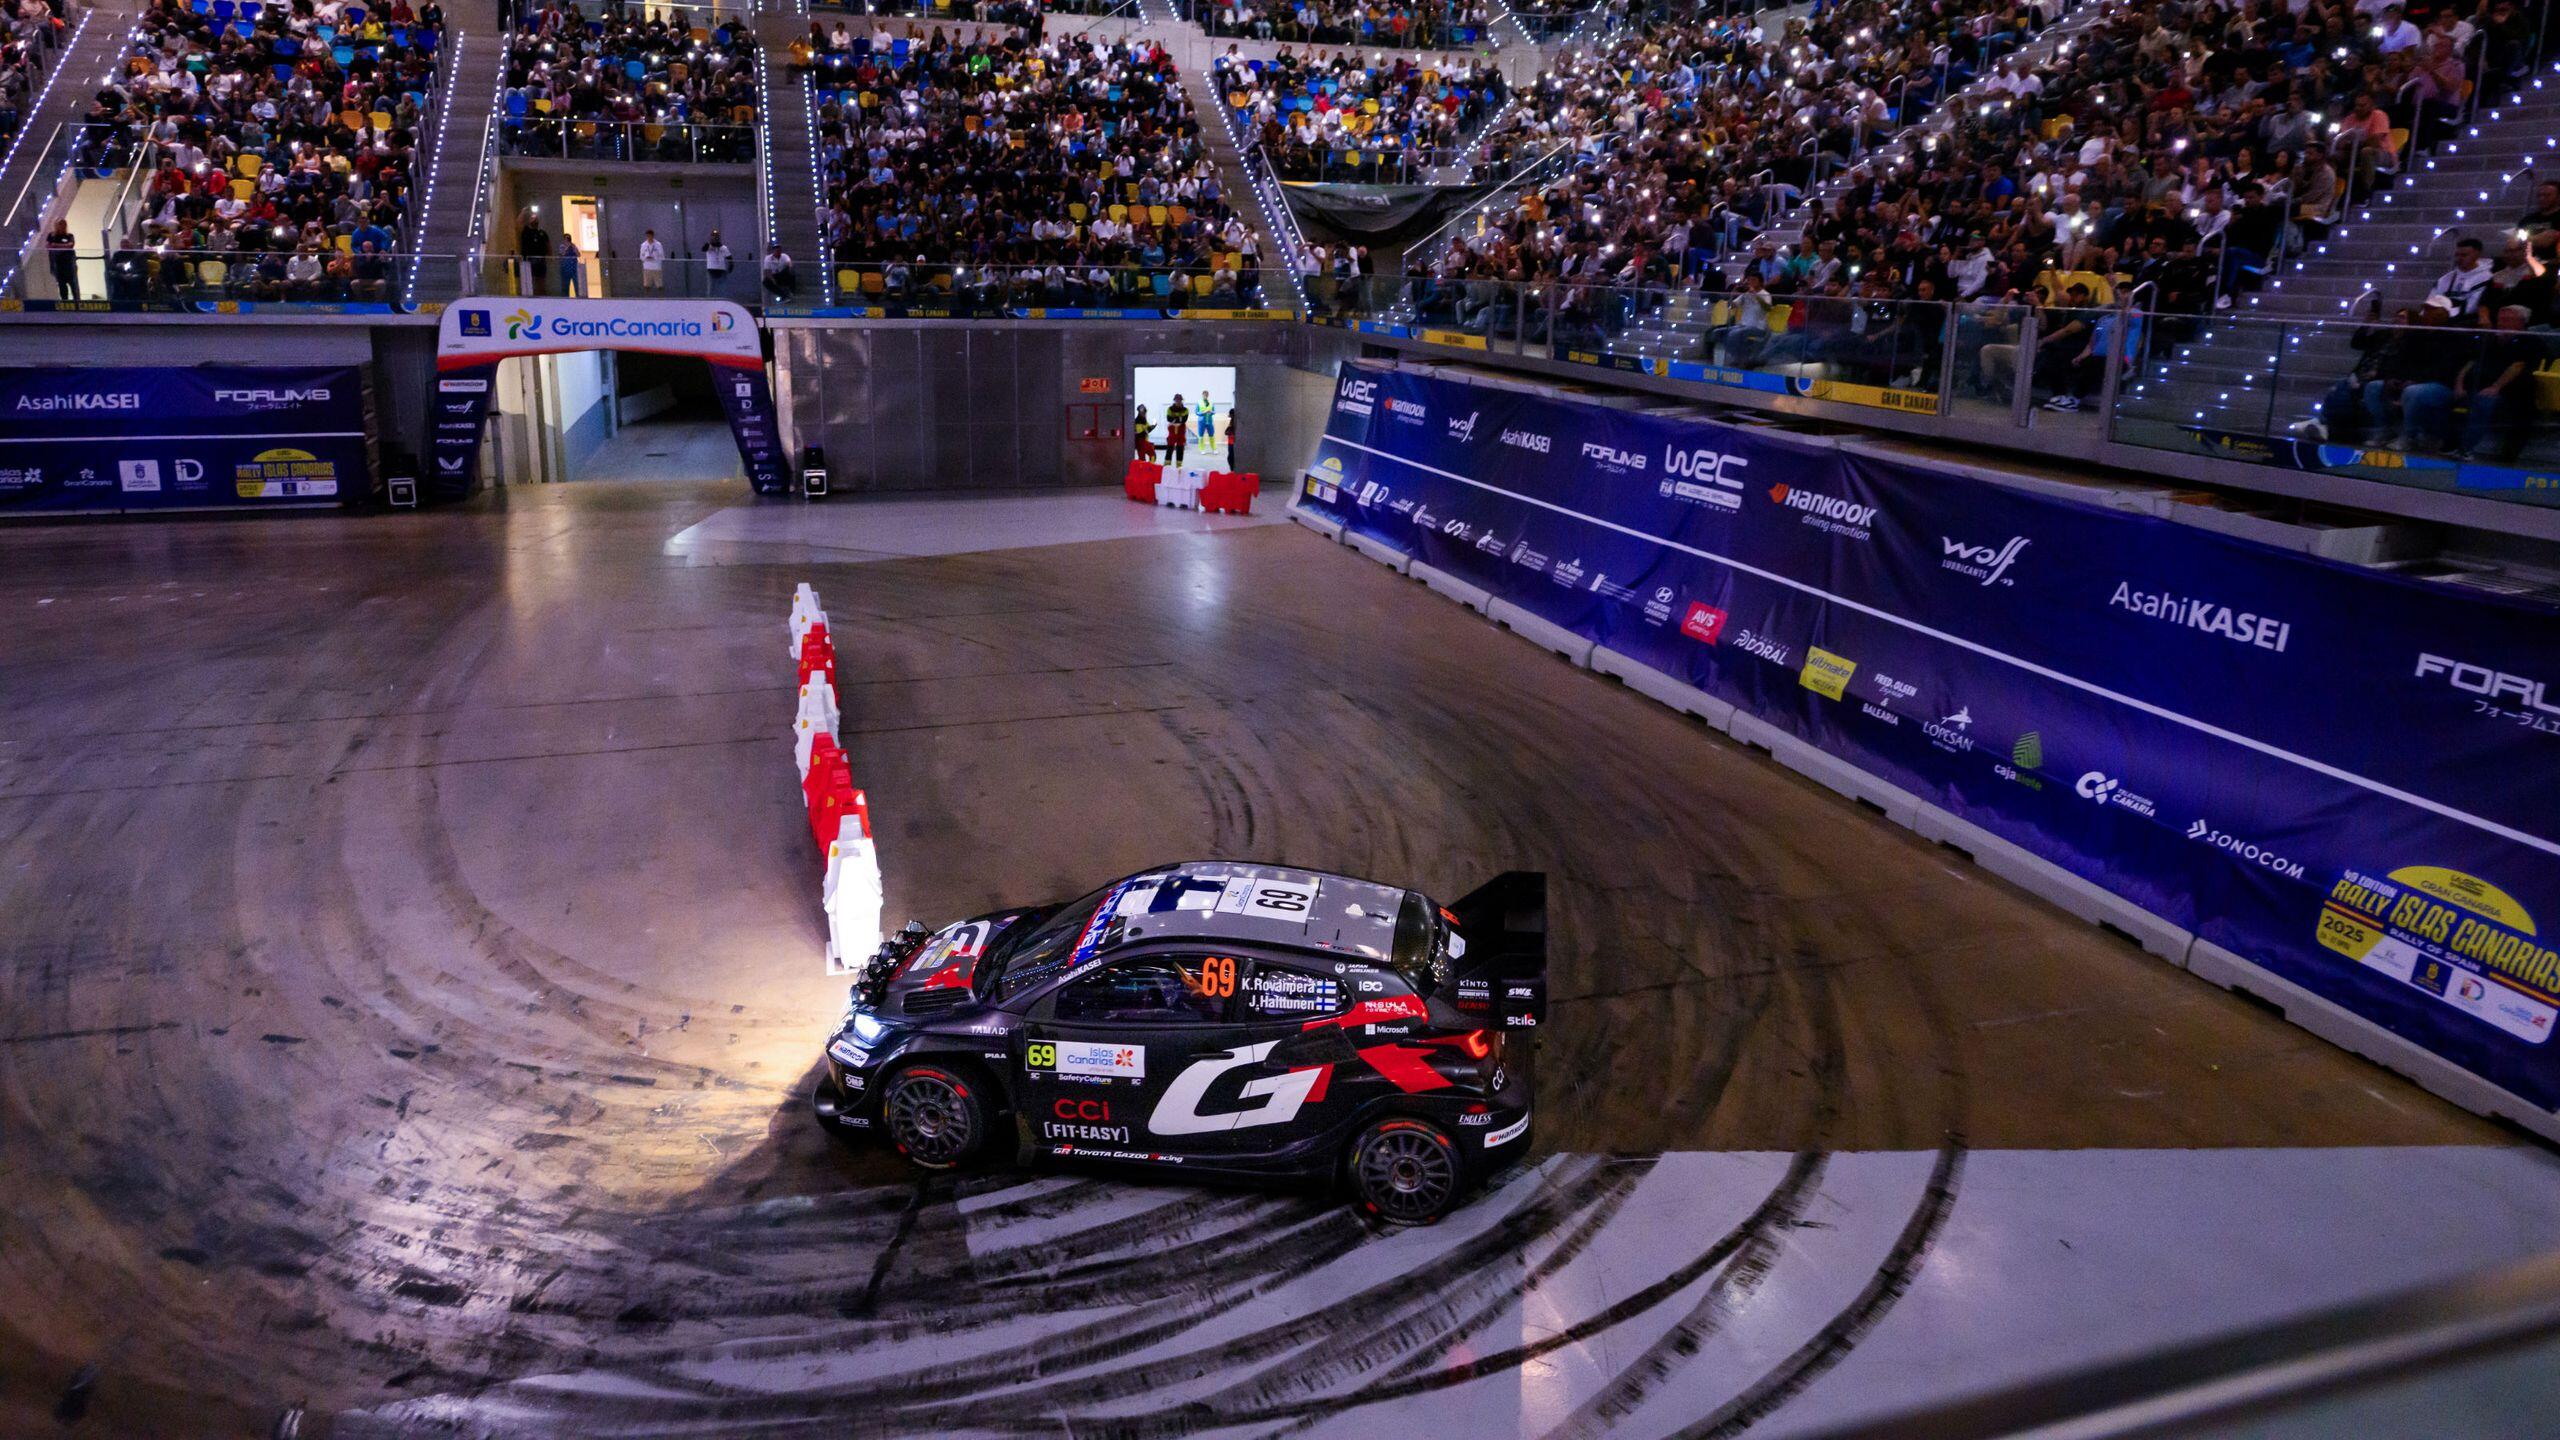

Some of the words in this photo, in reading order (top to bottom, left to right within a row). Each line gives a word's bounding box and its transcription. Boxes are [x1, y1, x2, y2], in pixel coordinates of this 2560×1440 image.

[552, 316, 701, 337] GranCanaria
[16, 392, 140, 411] AsahiKASEI
[214, 388, 331, 402] FORUM8
[1341, 376, 1378, 403] WRC
[1500, 428, 1552, 454] AsahiKASEI
[1582, 442, 1648, 471] FORUM8
[1664, 443, 1749, 490] WRC
[1802, 513, 1830, 533] driving
[1831, 522, 1872, 542] emotion
[1942, 558, 1988, 580] LUBRICANTS
[2110, 581, 2292, 653] AsahiKASEI
[1922, 720, 1975, 753] LOPESAN
[2111, 793, 2157, 819] CANARIA
[2207, 829, 2305, 880] SONOCOM
[2331, 879, 2391, 917] RALLY
[2388, 892, 2458, 945] ISLAS
[2324, 915, 2365, 943] 2025
[1057, 959, 1102, 985] AsahiKASEI
[1202, 957, 1235, 998] 69
[1376, 1025, 1409, 1035] Microsoft
[1506, 1014, 1537, 1026] Stilo
[1027, 1044, 1056, 1067] 69
[1066, 1054, 1115, 1067] Canarias
[1089, 1047, 1114, 1057] Islas
[1458, 1113, 1492, 1124] ENDLESS
[1073, 1148, 1111, 1158] TOYOTA
